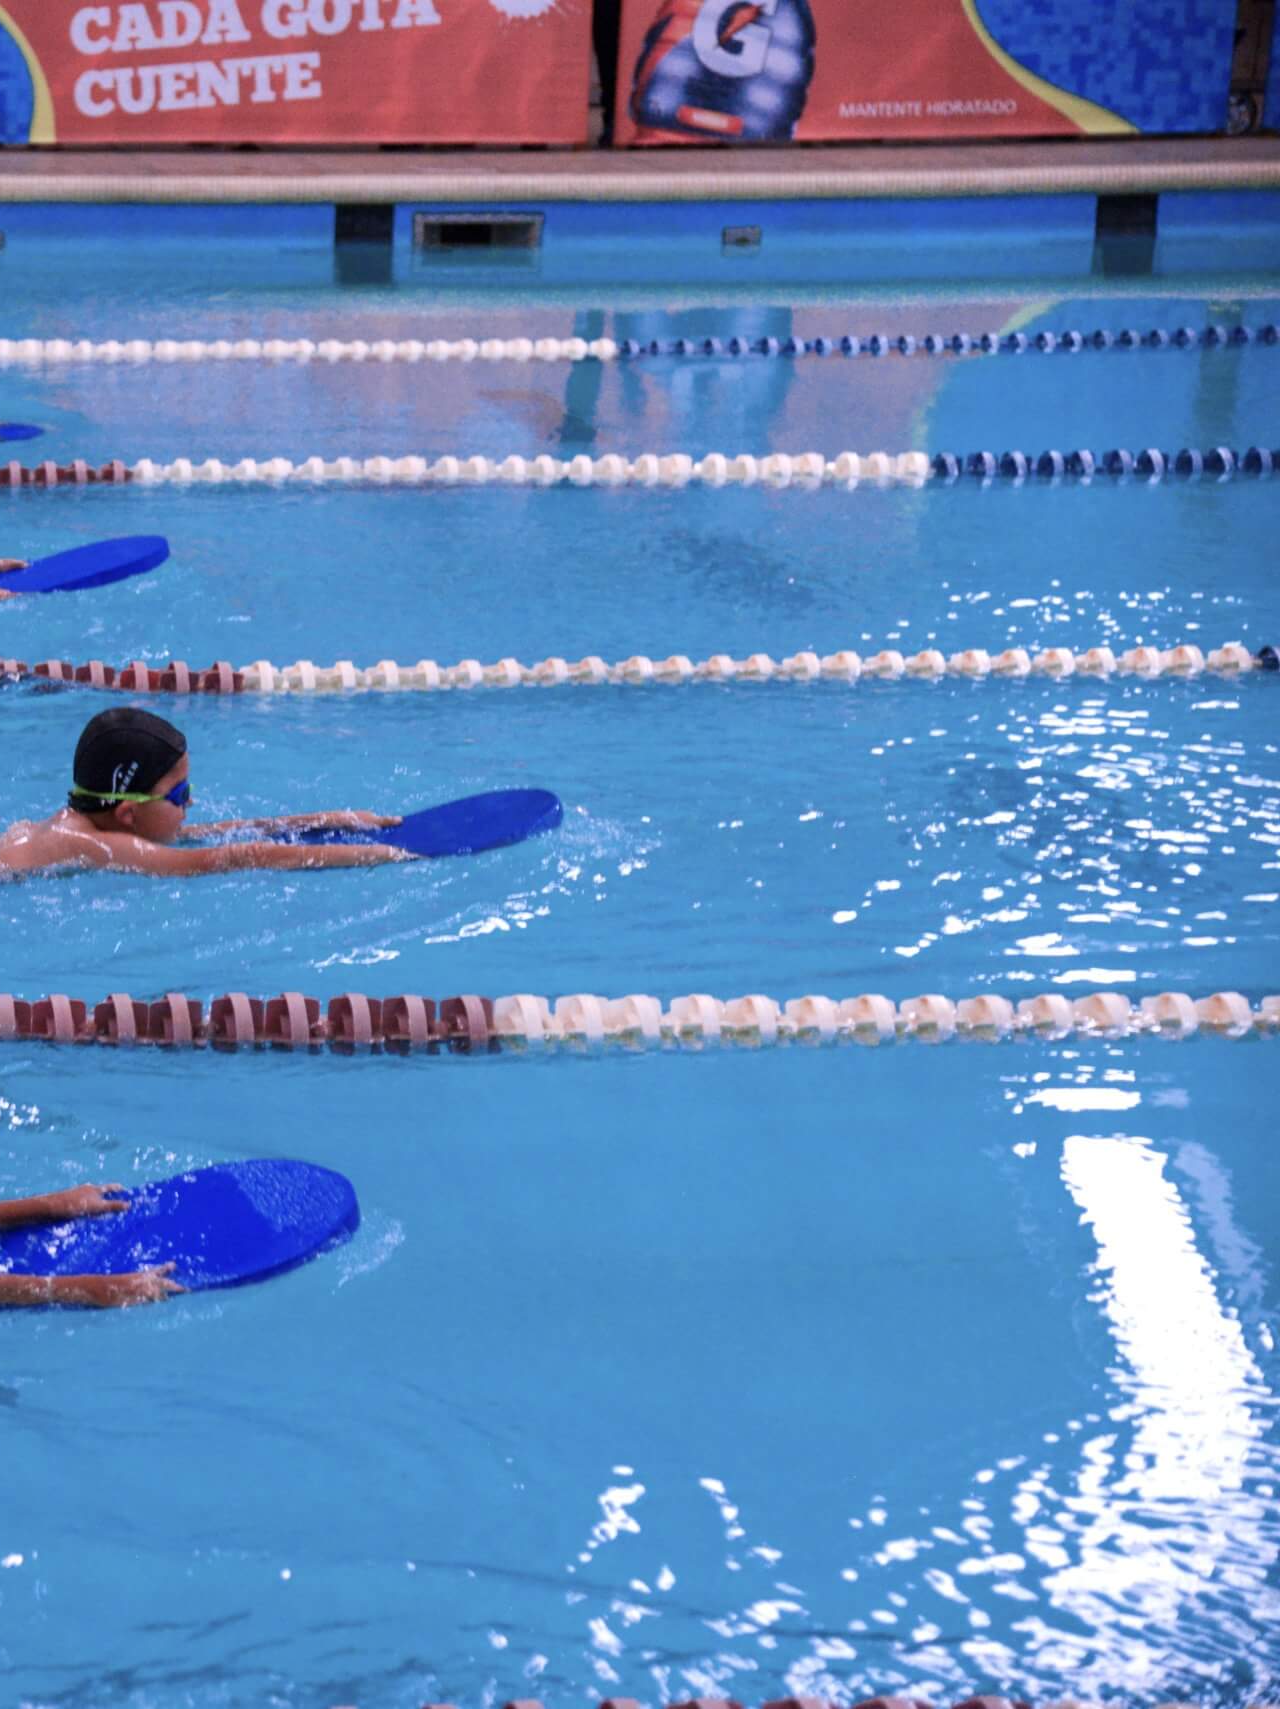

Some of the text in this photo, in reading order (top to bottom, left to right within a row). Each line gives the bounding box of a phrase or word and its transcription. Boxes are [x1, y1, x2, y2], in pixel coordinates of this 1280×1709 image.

[70, 0, 251, 55] CADA
[73, 51, 322, 117] CUENTE
[838, 99, 1017, 117] MANTENTE HIDRATADO
